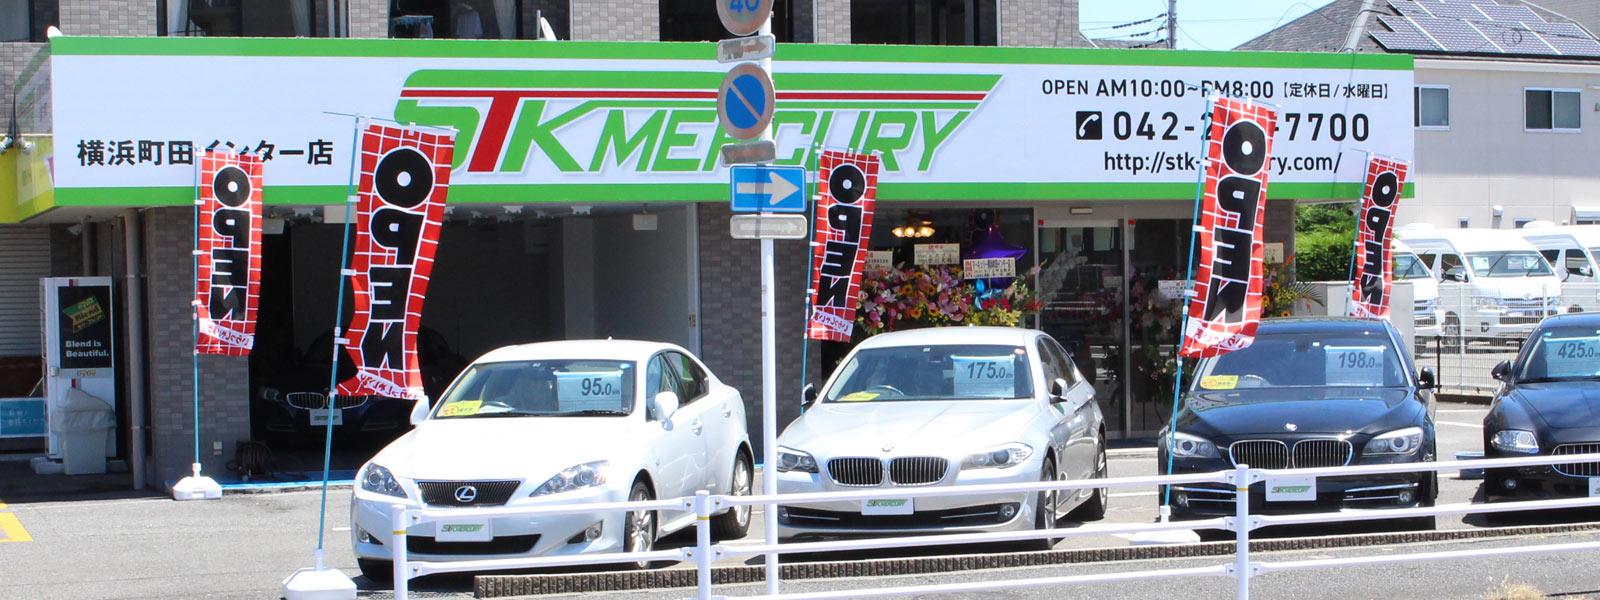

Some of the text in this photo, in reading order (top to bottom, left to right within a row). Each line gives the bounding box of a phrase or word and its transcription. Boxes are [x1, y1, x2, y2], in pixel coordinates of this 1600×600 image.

[730, 0, 760, 13] 40
[1042, 80, 1089, 95] OPEN
[1113, 112, 1369, 141] 042-2-7700
[1104, 151, 1342, 176] http://stk-ry.com/
[65, 340, 91, 348] Blend
[66, 350, 110, 358] Beautiful.
